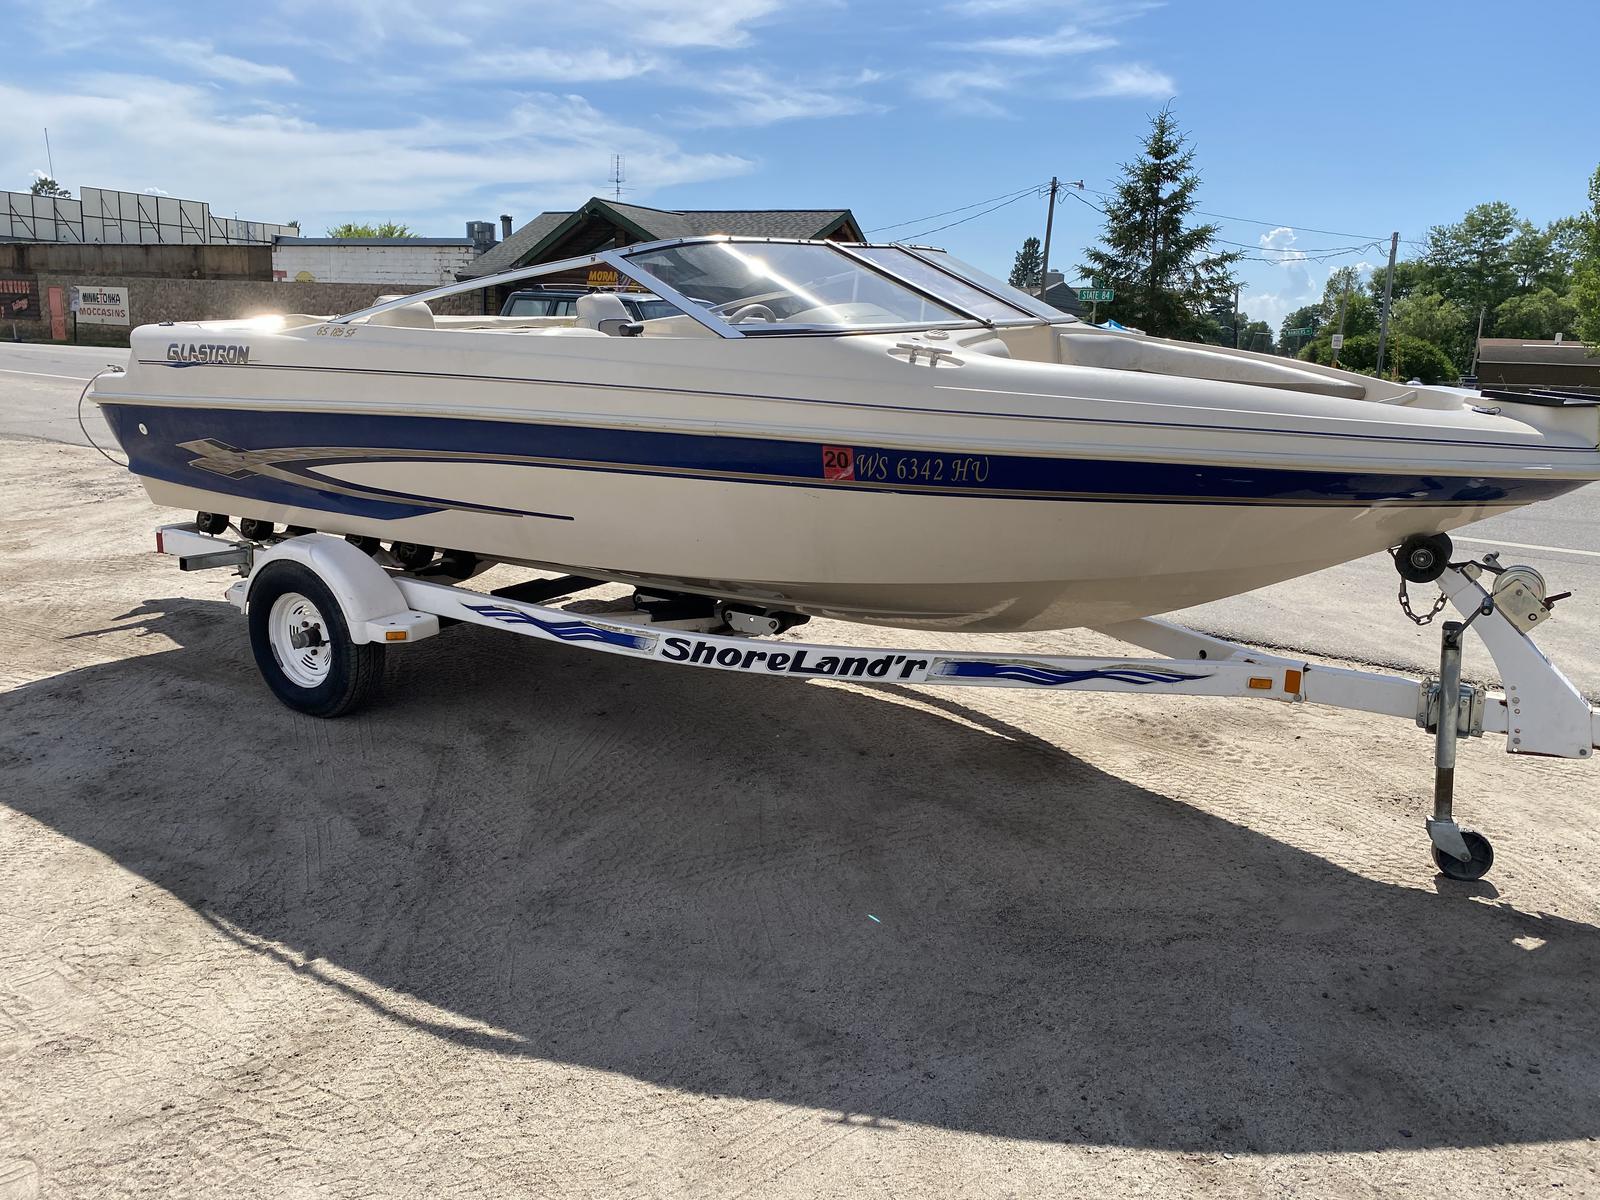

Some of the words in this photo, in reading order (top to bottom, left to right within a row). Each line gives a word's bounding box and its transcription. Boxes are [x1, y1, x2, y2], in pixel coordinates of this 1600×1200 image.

[82, 288, 121, 304] MINNETONKA
[1082, 290, 1099, 300] STATE
[1101, 290, 1110, 300] 84
[79, 307, 126, 318] MOCCASINS
[167, 343, 250, 364] GLASTRON
[825, 451, 849, 469] 20
[856, 453, 889, 480] WS
[896, 457, 944, 481] 6342
[661, 637, 928, 679] ShoreLand'r
